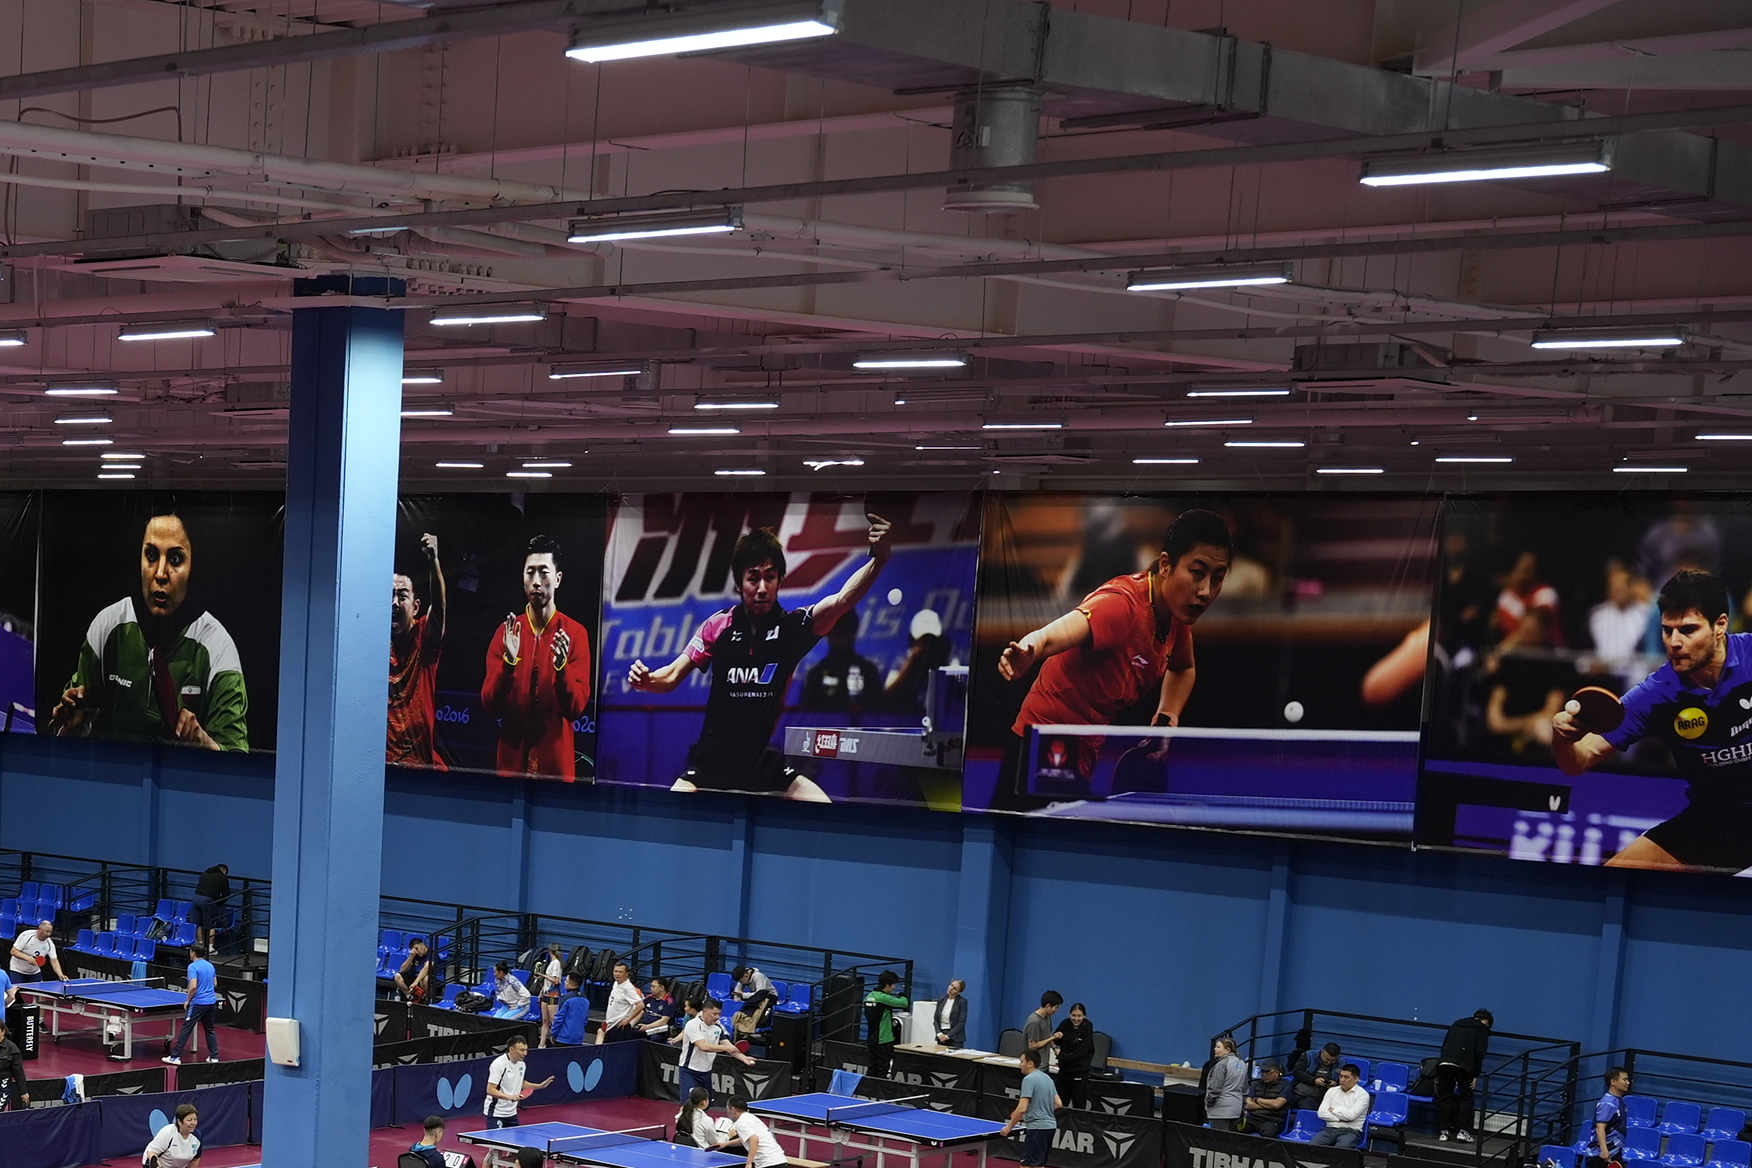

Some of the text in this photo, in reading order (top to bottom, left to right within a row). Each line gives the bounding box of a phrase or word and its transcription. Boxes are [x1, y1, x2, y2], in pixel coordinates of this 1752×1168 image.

[727, 667, 759, 684] ANA
[1677, 716, 1705, 731] ARAG
[26, 1015, 34, 1052] BUTTERFLY
[660, 1063, 735, 1095] TIAR
